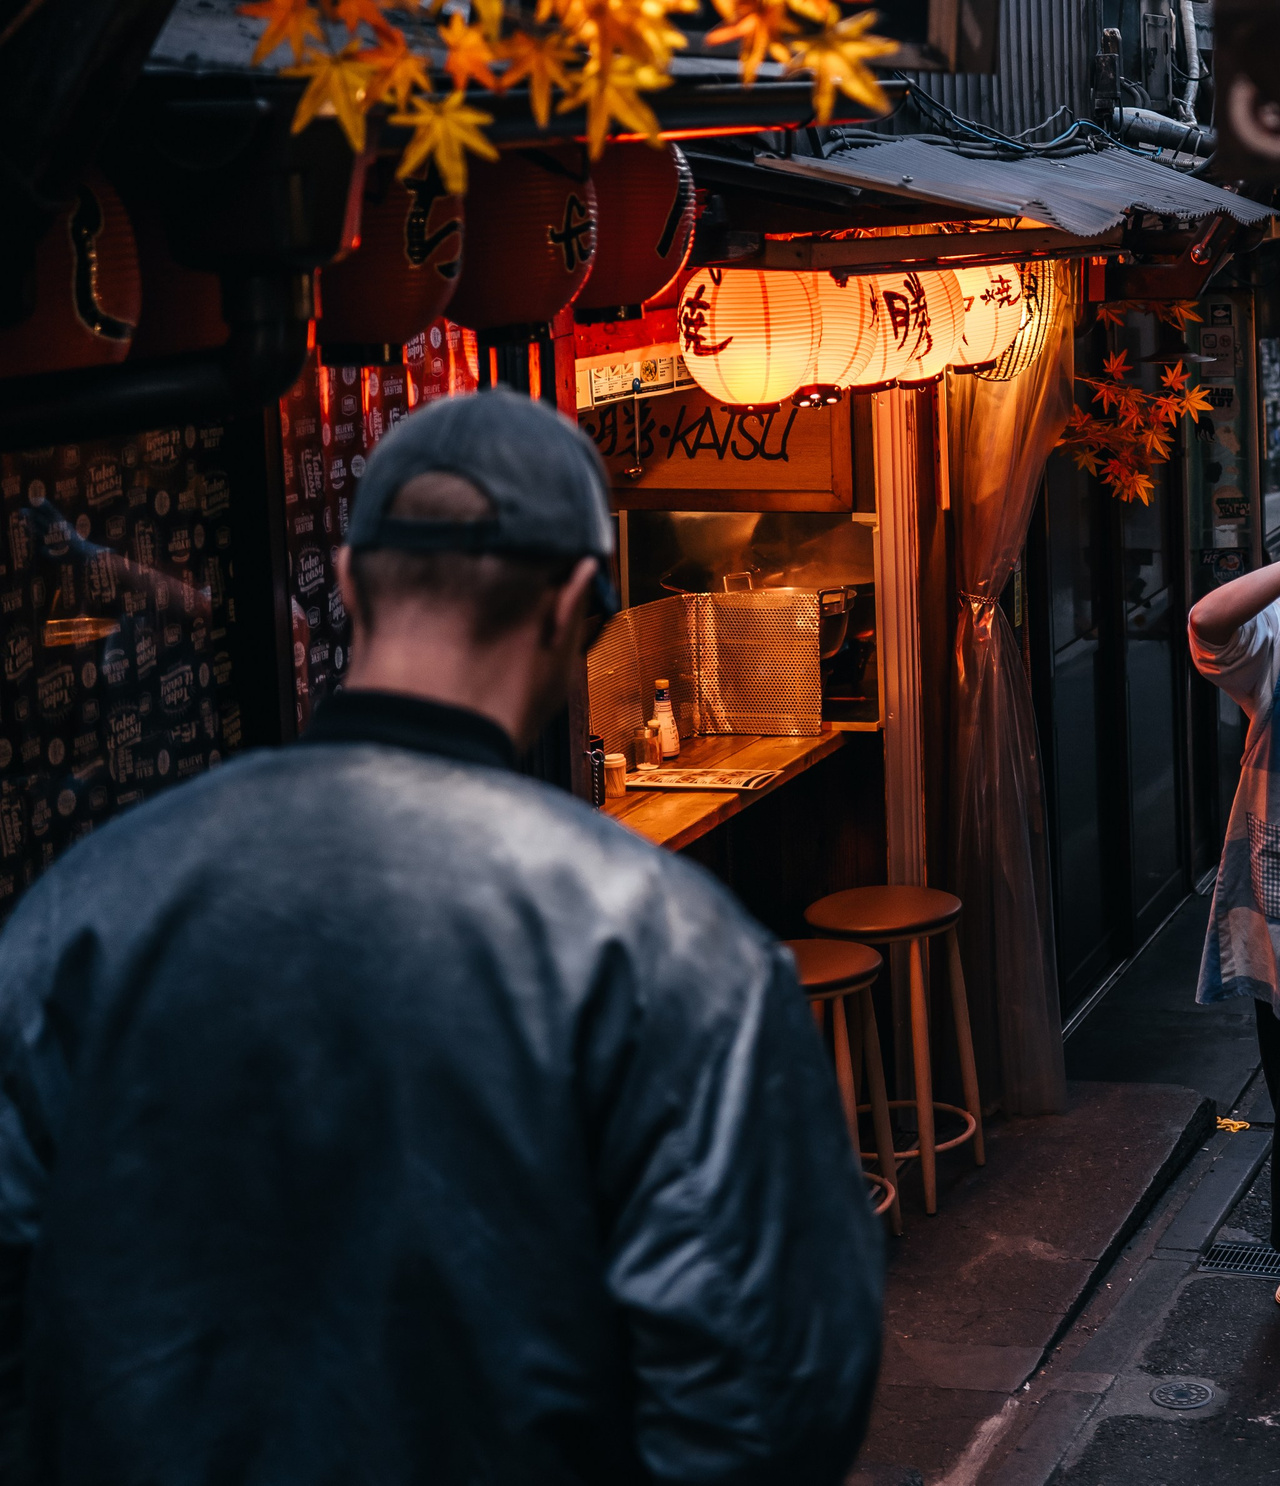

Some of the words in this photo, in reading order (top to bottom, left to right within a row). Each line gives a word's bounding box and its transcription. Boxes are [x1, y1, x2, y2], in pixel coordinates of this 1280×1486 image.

[89, 464, 117, 482] Take
[300, 555, 320, 572] Take
[305, 563, 325, 583] easy
[110, 714, 137, 733] Take
